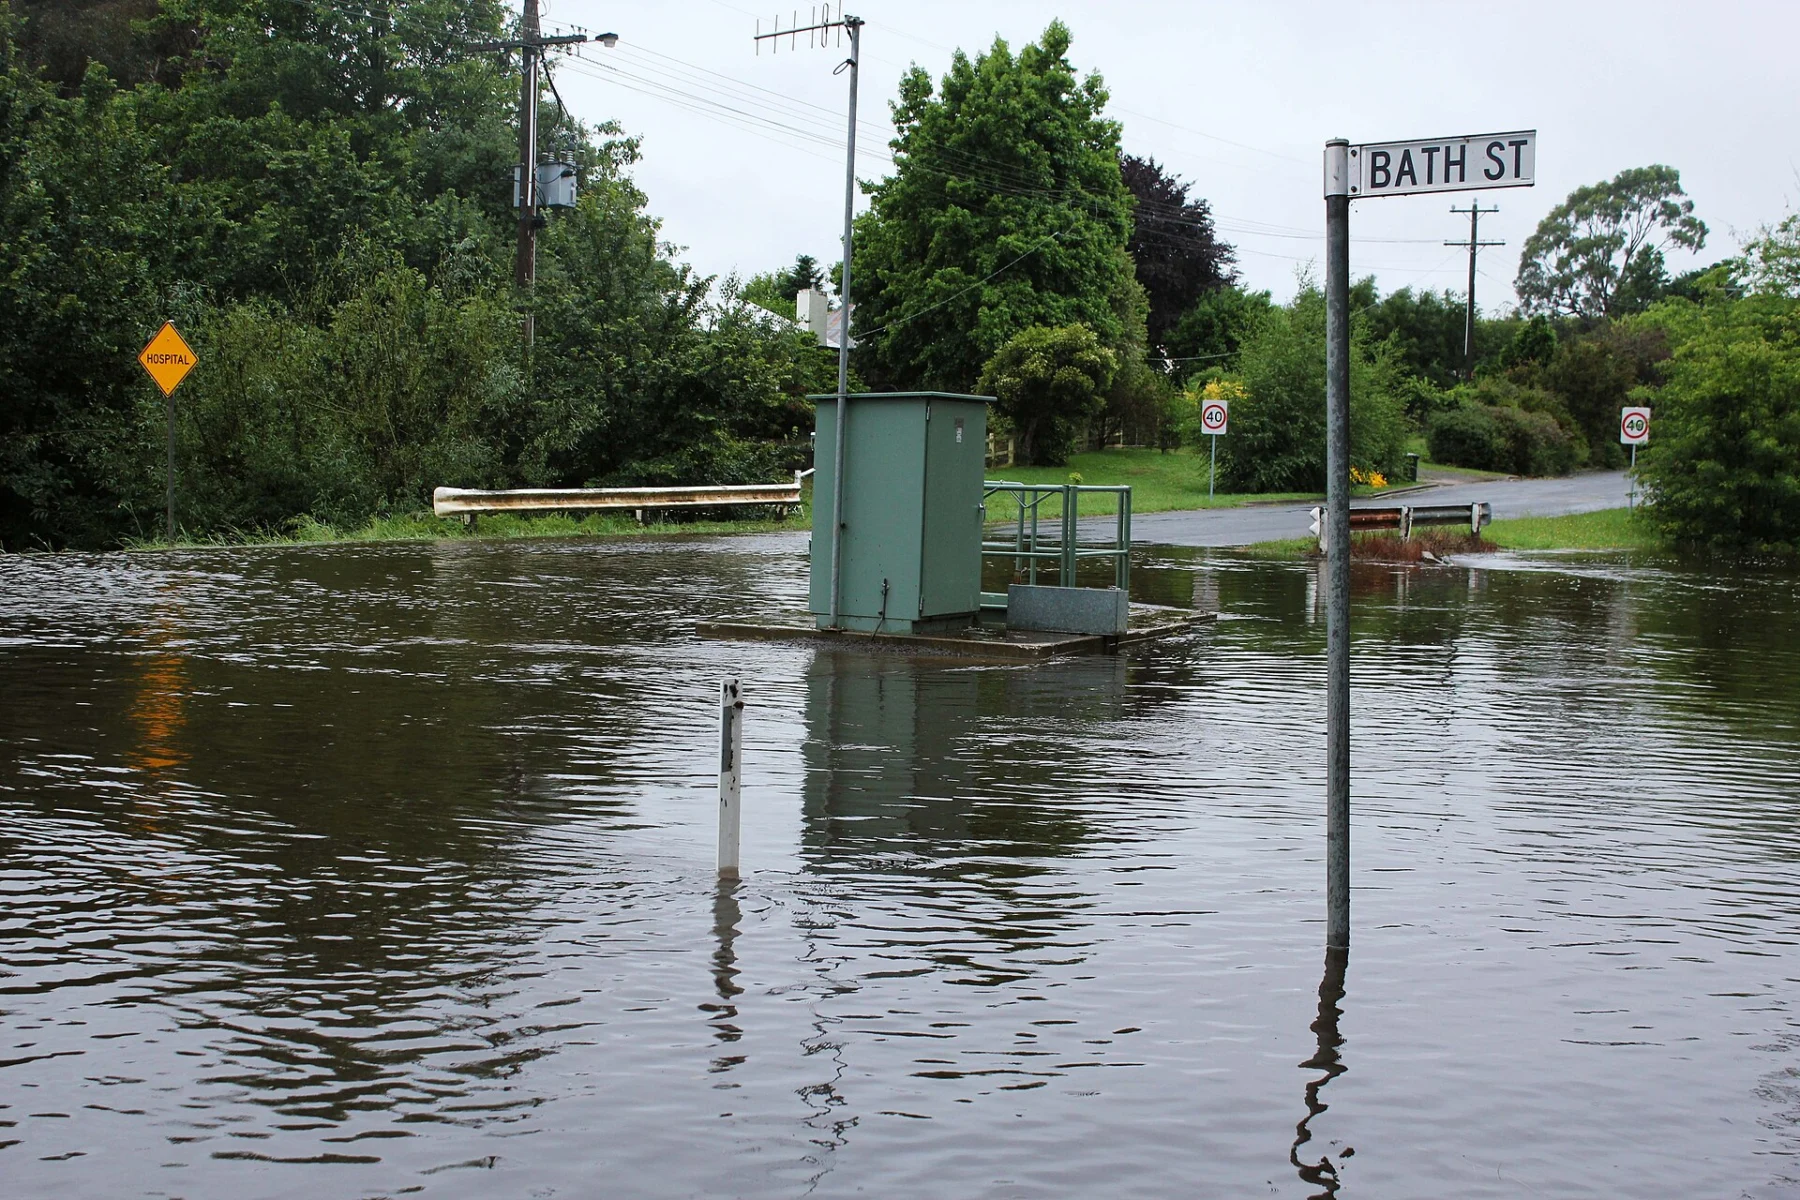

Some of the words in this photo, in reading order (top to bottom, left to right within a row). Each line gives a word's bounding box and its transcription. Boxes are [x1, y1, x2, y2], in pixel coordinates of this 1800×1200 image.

[1370, 144, 1466, 189] BATH
[1483, 139, 1528, 181] ST
[146, 353, 190, 365] HOSPITAL
[1206, 411, 1222, 423] 40
[1626, 419, 1645, 432] 40
